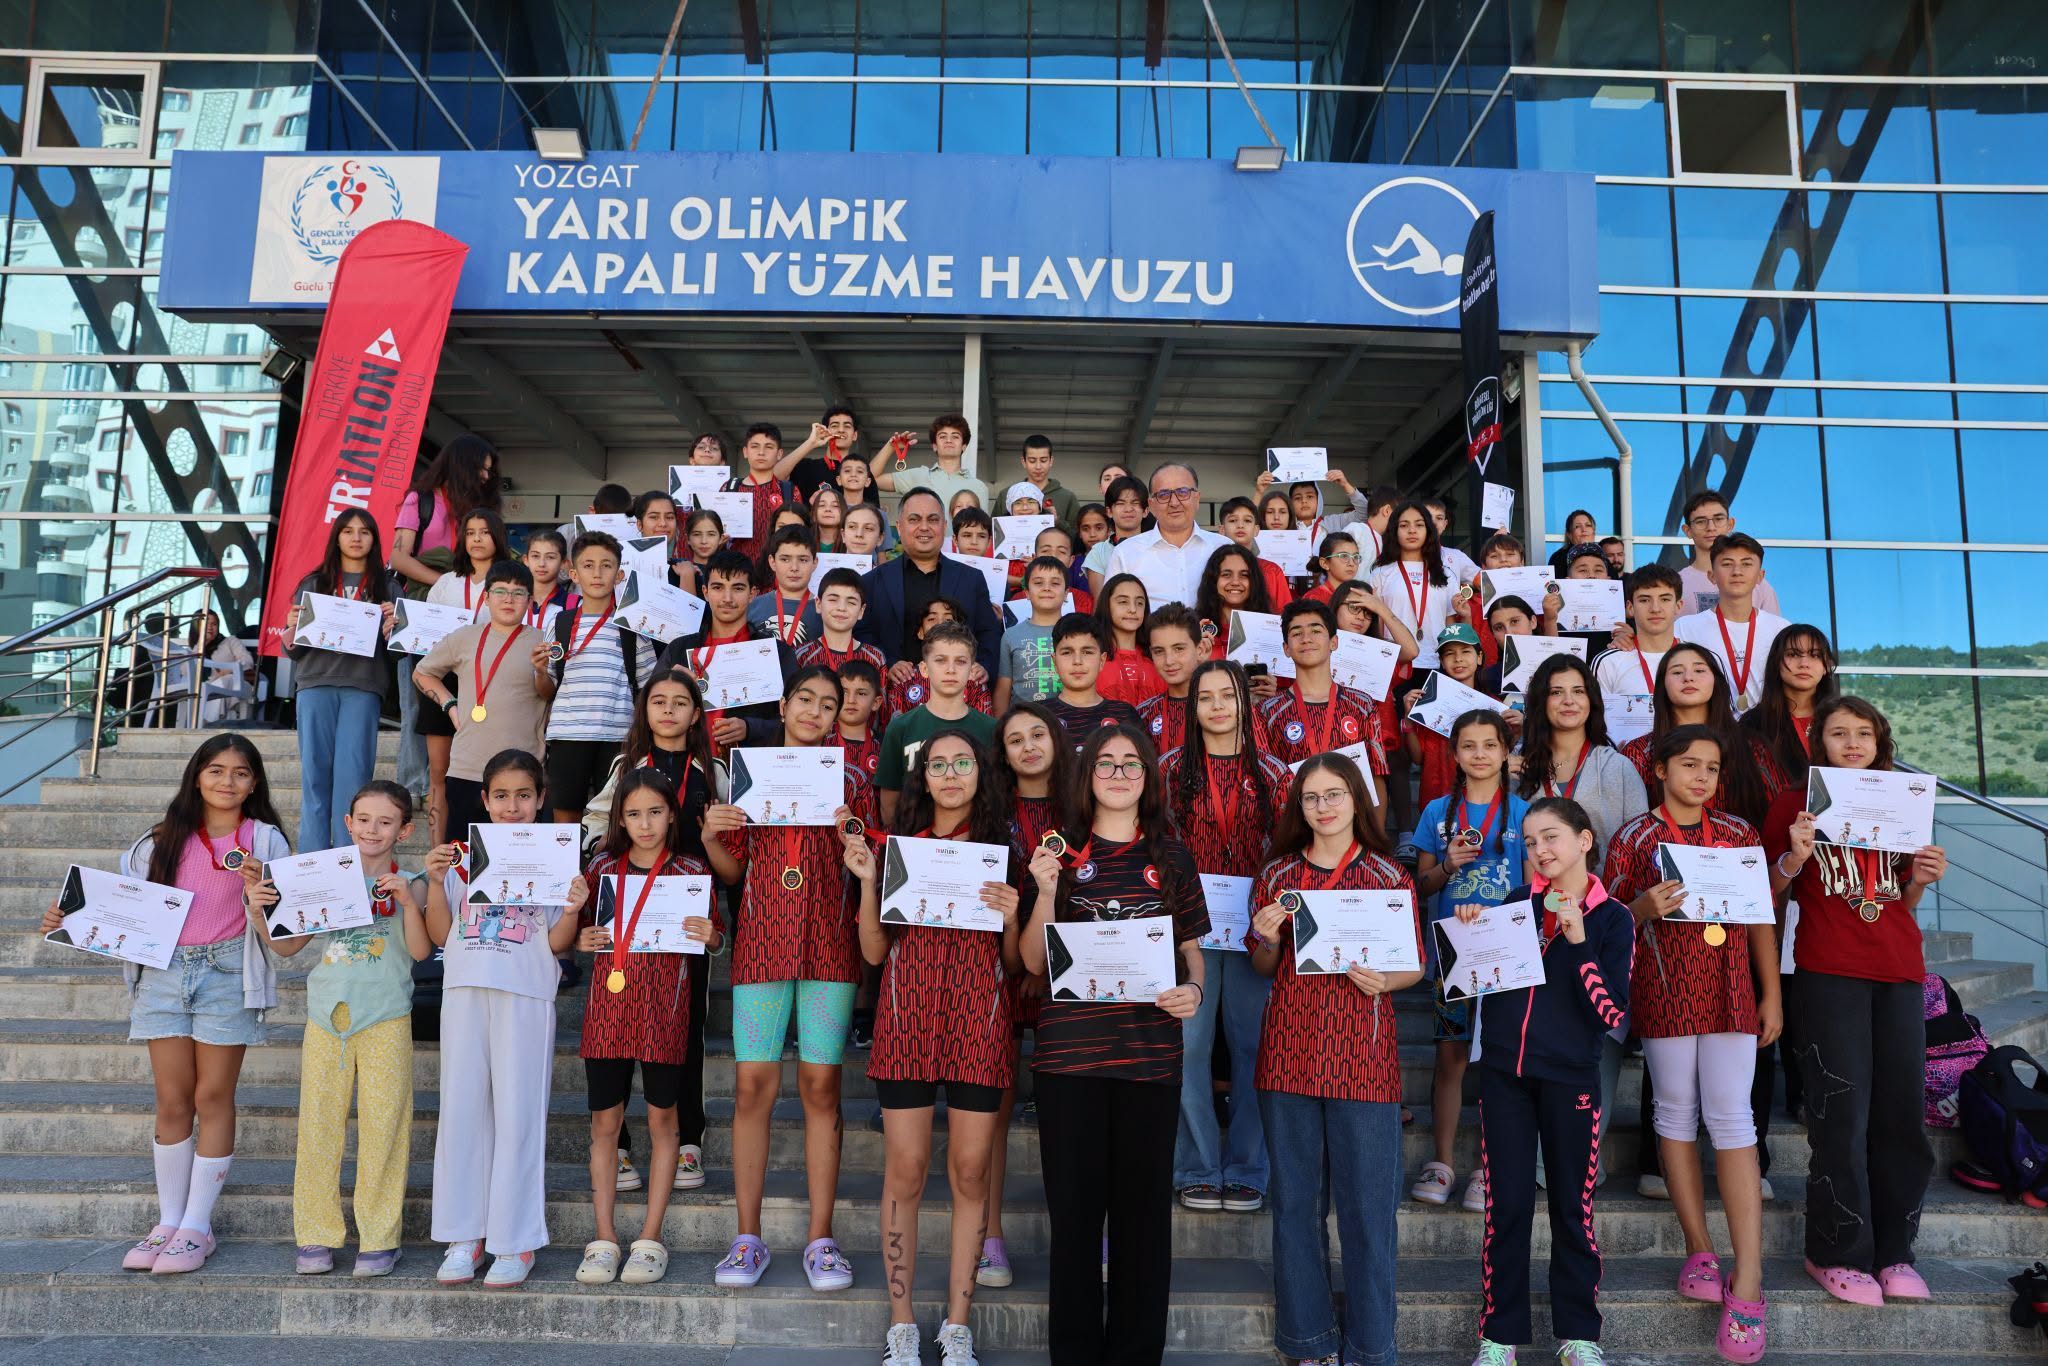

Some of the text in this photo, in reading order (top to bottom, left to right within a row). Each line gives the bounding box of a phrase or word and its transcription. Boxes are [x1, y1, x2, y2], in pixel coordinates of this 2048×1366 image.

[513, 163, 641, 190] YOZGAT
[513, 196, 650, 241] YARI
[321, 238, 351, 247] BAKAN
[294, 281, 324, 292] Güçlü
[506, 250, 1234, 306] KAPALI YÜZME HAVUZU
[315, 352, 354, 422] TÜRKİYE
[380, 372, 426, 490] FEDERASYONU
[1444, 624, 1462, 637] NY
